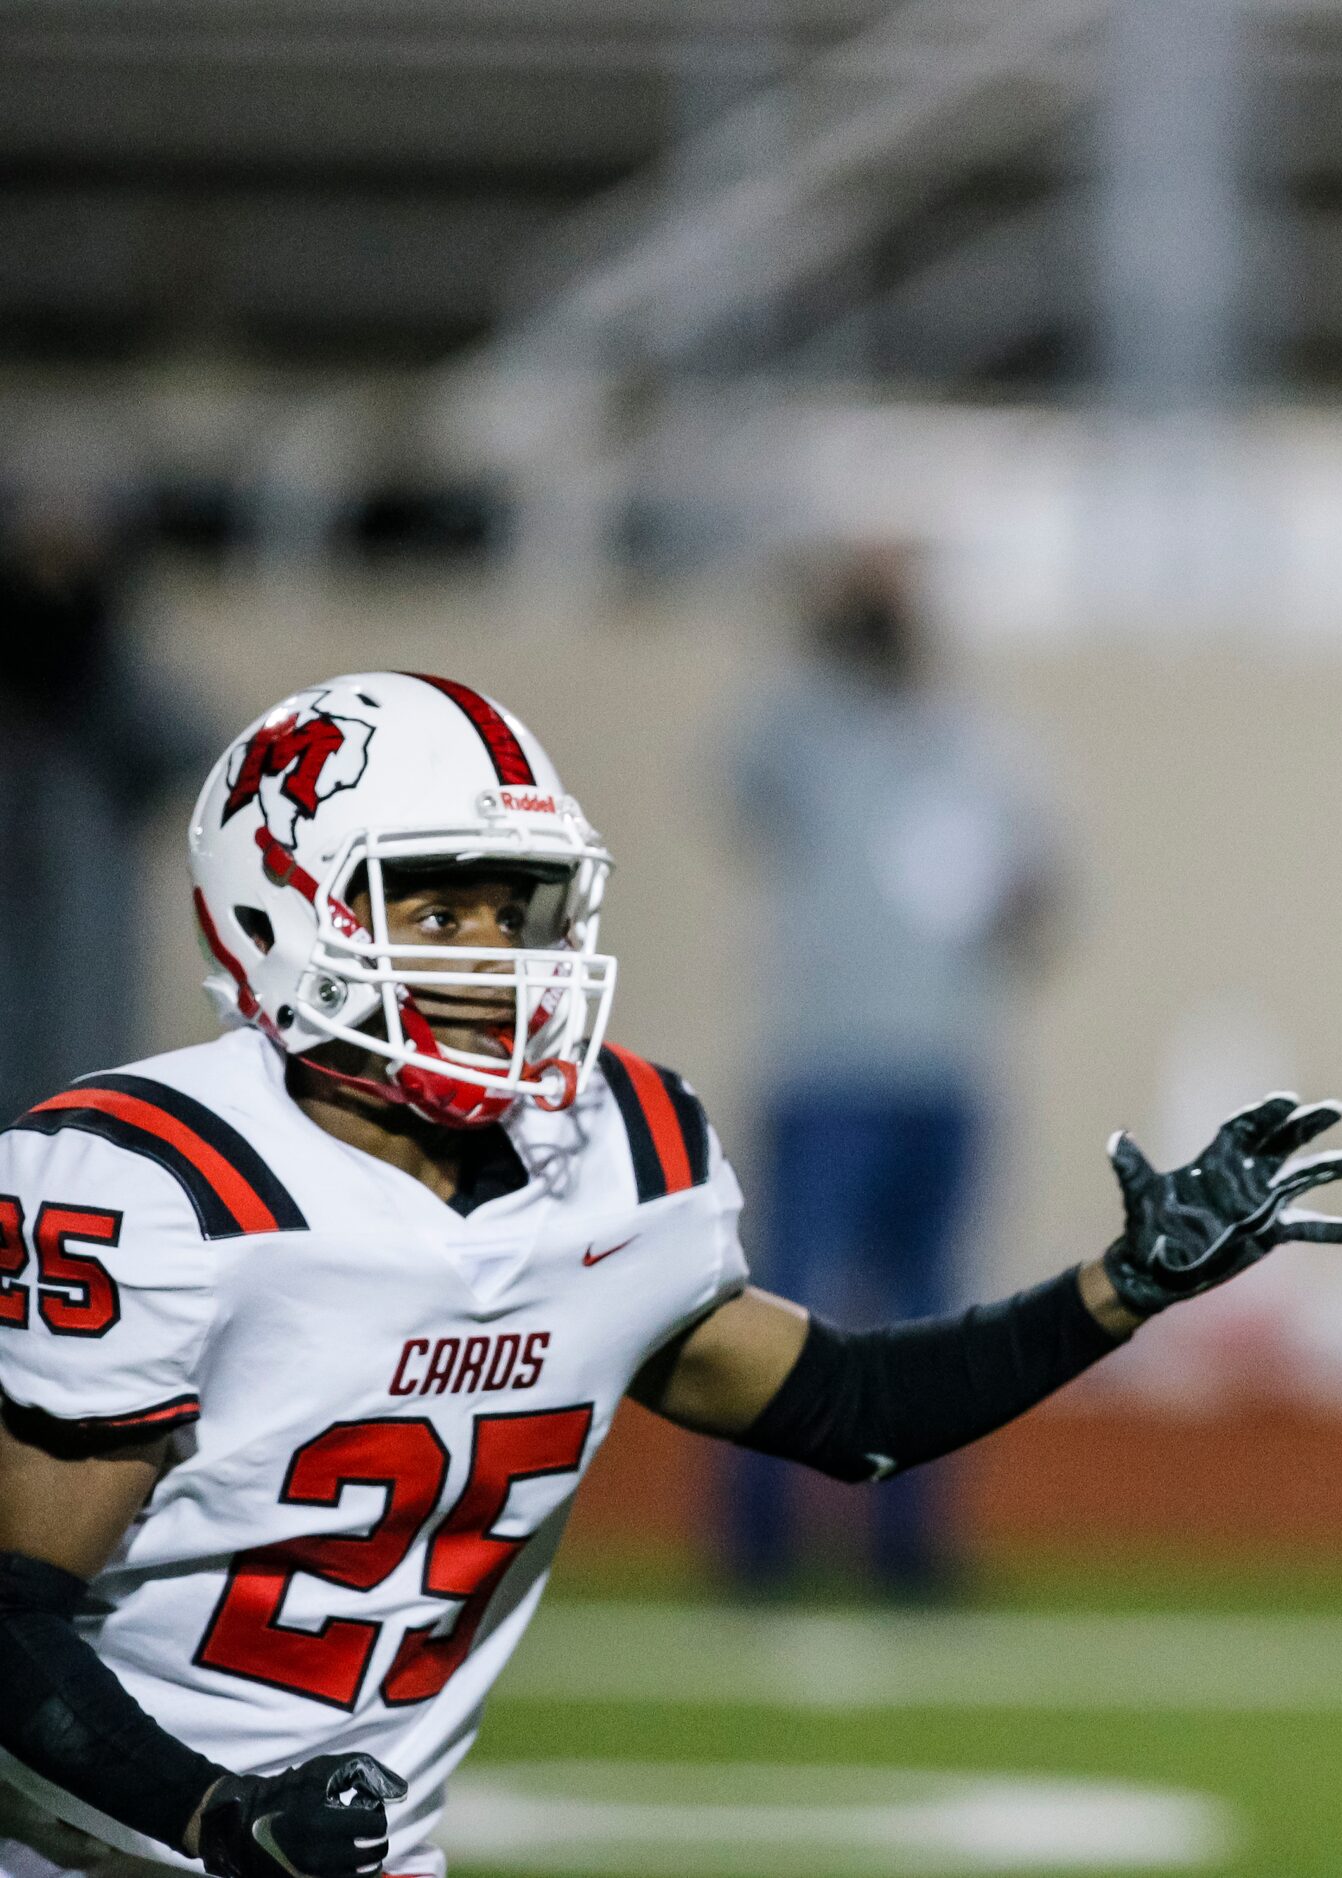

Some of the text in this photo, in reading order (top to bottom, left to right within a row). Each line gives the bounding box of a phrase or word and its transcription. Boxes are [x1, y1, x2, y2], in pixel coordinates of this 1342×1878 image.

[220, 712, 345, 829] M
[389, 1331, 552, 1396] CARDS
[192, 1402, 594, 1713] 25
